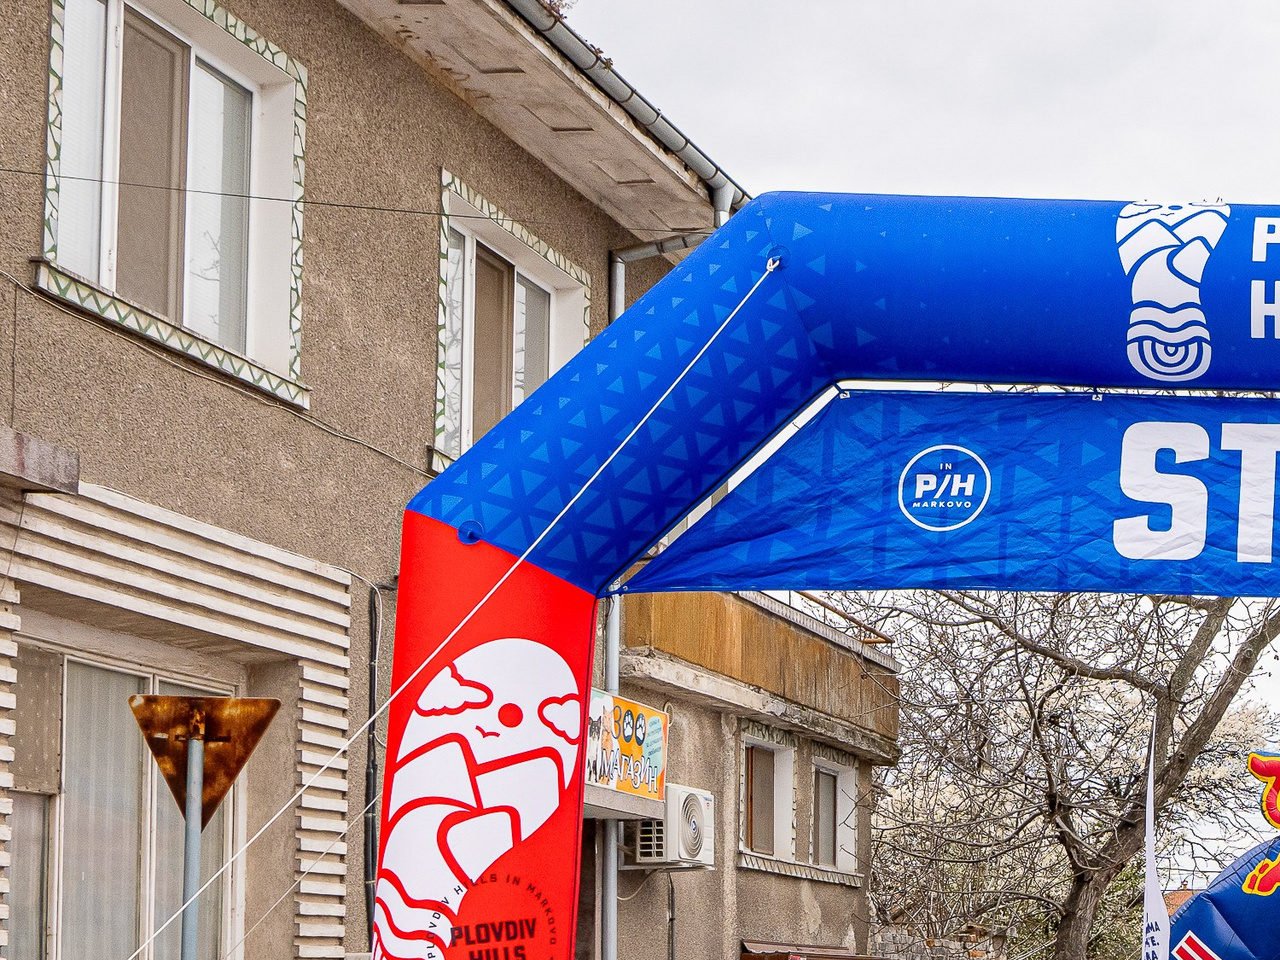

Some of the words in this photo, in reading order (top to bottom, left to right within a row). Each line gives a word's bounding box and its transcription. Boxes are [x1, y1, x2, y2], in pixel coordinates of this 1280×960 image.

[915, 474, 975, 499] P/H
[599, 747, 658, 793] МАГАЗИН
[427, 895, 450, 959] PLOVDIV
[453, 873, 498, 896] HILLS
[506, 874, 521, 886] IN
[526, 882, 557, 946] MARKOVO
[450, 918, 537, 948] PLOVDIV
